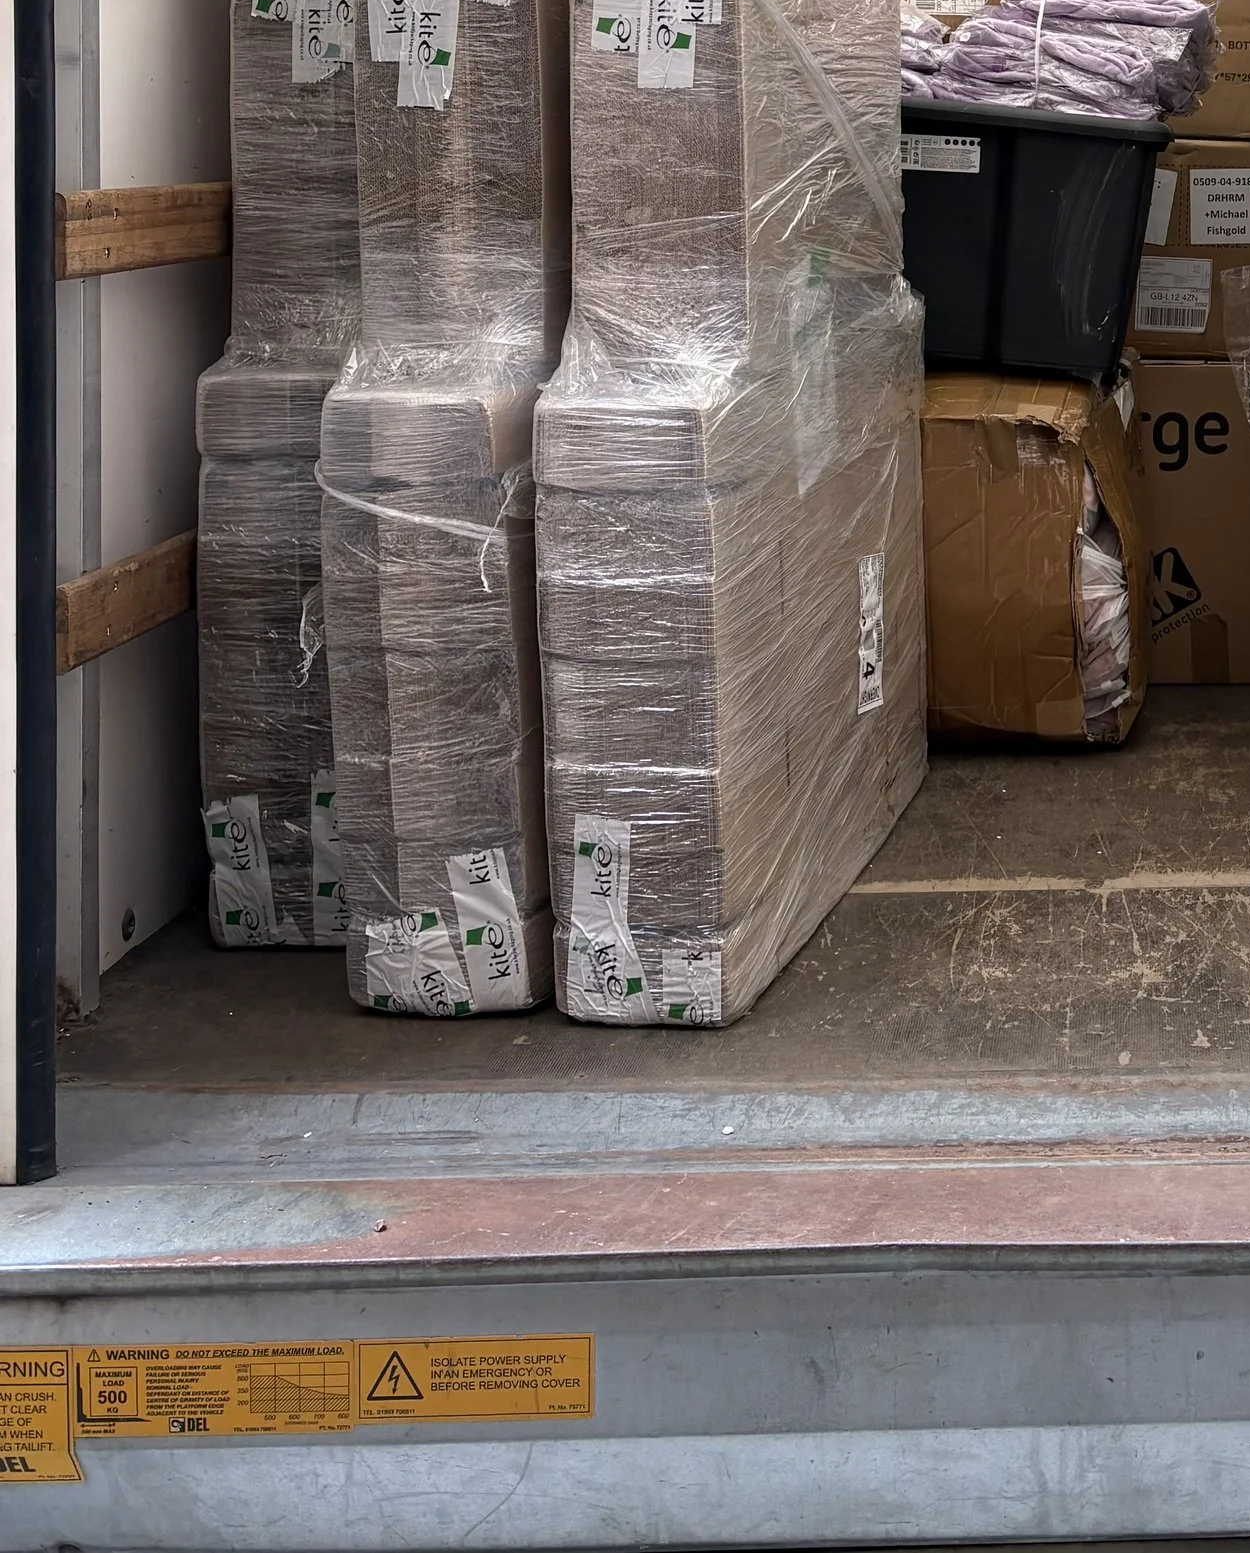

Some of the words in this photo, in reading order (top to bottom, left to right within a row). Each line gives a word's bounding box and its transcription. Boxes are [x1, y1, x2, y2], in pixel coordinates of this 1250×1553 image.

[308, 9, 328, 60] kite
[418, 12, 441, 67] kite
[1207, 193, 1245, 202] DRHRM
[1205, 209, 1249, 219] +Michael
[1207, 226, 1246, 236] Fishgold
[1151, 603, 1210, 644] protection
[231, 820, 251, 872] kite
[591, 843, 613, 897] kite
[488, 923, 511, 980] kite
[421, 970, 451, 1016] kite
[106, 1349, 170, 1361] WARNING
[176, 1350, 191, 1358] DO
[191, 1350, 211, 1358] NOT
[213, 1348, 249, 1357] EXCEED
[252, 1348, 269, 1357] THE
[272, 1347, 315, 1356] MAXIMUM
[317, 1346, 345, 1355] LOAD.
[430, 1357, 476, 1367] ISOLATE
[479, 1356, 521, 1366] POWER
[524, 1354, 566, 1365] SUPPLY
[430, 1370, 441, 1379] IN
[443, 1369, 460, 1379] AN
[462, 1368, 533, 1378] EMERGENCY
[536, 1367, 553, 1376] OR
[430, 1381, 476, 1391] BEFORE
[479, 1380, 538, 1390] REMOVING
[544, 1378, 581, 1388] COVER
[98, 1391, 127, 1404] 500
[10, 1405, 47, 1414] CLEAR
[17, 1418, 32, 1427] OF
[187, 1417, 210, 1432] DEL
[10, 1430, 43, 1439] WHEN
